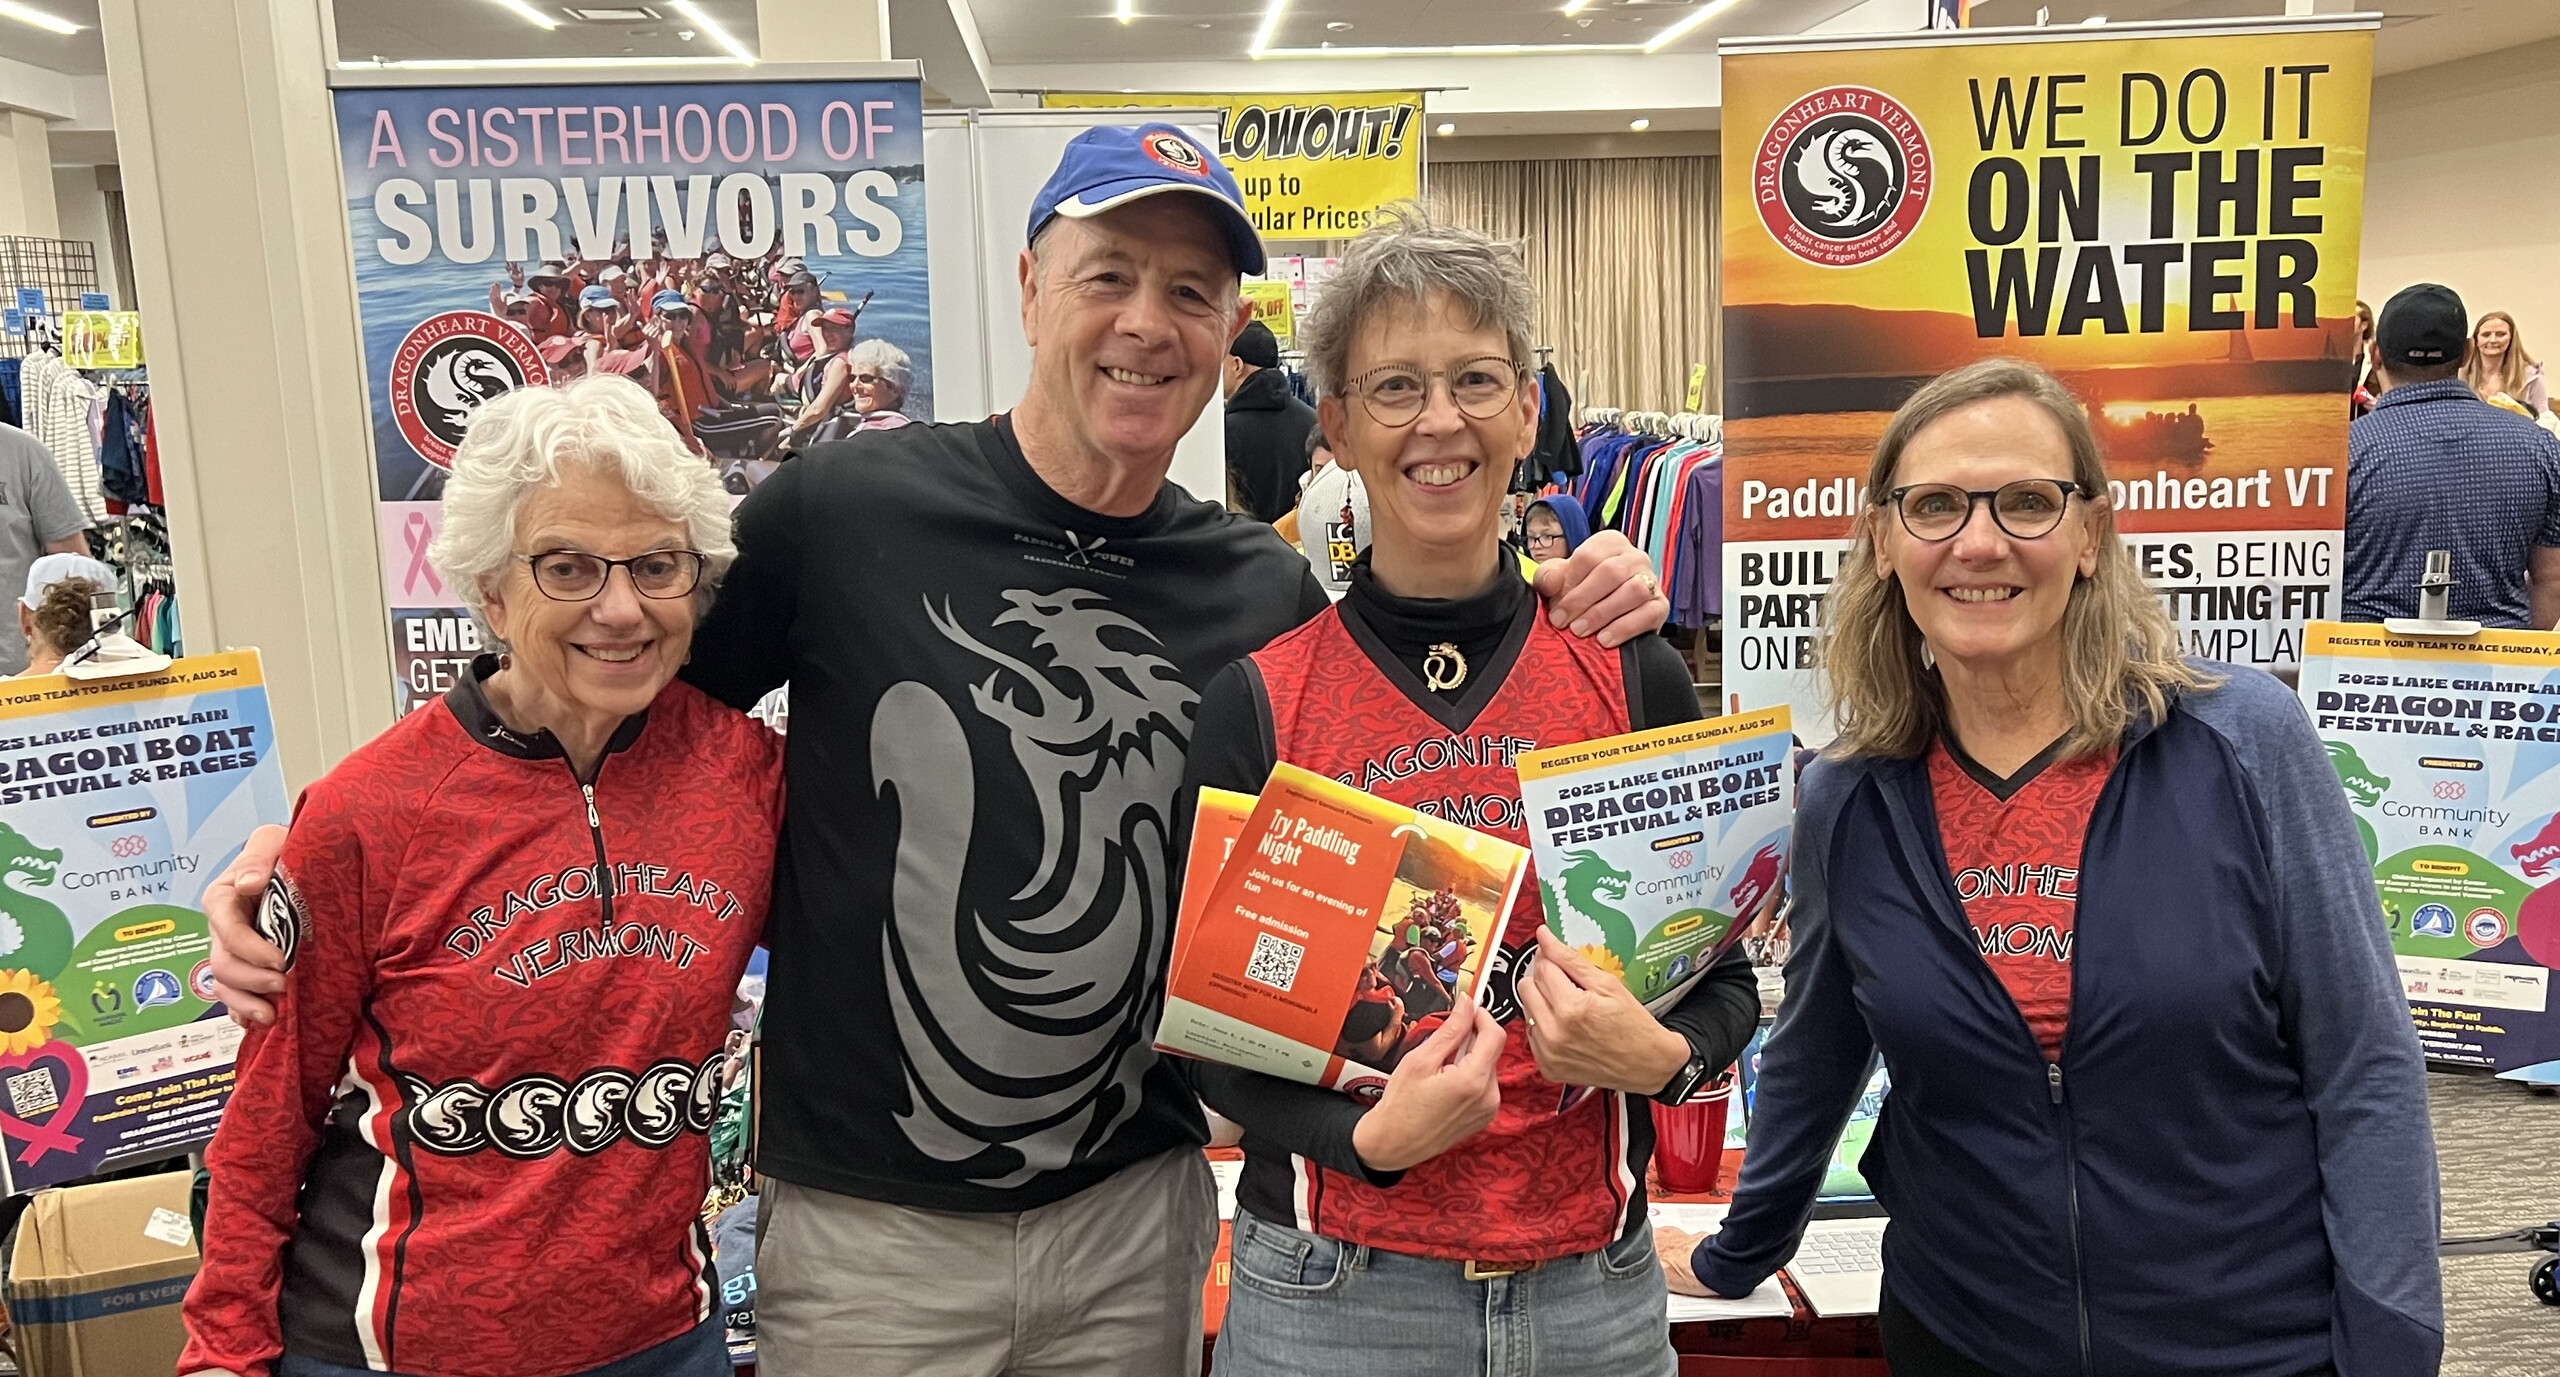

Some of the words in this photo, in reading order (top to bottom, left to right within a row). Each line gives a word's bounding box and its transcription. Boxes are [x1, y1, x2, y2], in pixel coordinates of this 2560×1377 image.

[1968, 75, 2086, 151] WE
[2121, 67, 2227, 147] DO
[2263, 64, 2329, 140] IT
[366, 110, 405, 168] A
[428, 103, 797, 168] SISTERHOOD
[822, 101, 894, 161] OF
[1219, 104, 1416, 162] LOWOUT!
[1761, 93, 1872, 204] DRAGONHEART
[1880, 102, 1926, 200] VERMONT
[1245, 176, 1271, 198] up
[1279, 172, 1300, 196] to
[1968, 155, 2101, 245] ON
[2135, 147, 2324, 239] THE
[375, 171, 903, 265] SURVIVORS
[1252, 206, 1296, 230] ular
[1783, 233, 1823, 259] supporter
[1826, 252, 1857, 263] dragon
[1858, 247, 1878, 258] boat
[1880, 229, 1903, 249] teams
[1788, 222, 1812, 245] breast
[1815, 240, 1844, 252] cancer
[1847, 233, 1881, 251] survivor
[1883, 219, 1898, 235] and
[1964, 239, 2319, 338] WATER
[1266, 298, 1284, 317] OFF
[396, 317, 491, 416] DRAGONHEART
[498, 325, 545, 386] VERMO
[421, 444, 453, 466] support
[423, 434, 448, 456] breast
[2111, 470, 2270, 511] onheart
[2285, 467, 2334, 507] VT
[1013, 533, 1067, 551] PADDLE
[1092, 551, 1136, 567] POWER
[1329, 543, 1357, 562] DB
[2217, 541, 2330, 578] BEING
[2153, 585, 2272, 621] TTING
[2282, 585, 2331, 620] FIT
[405, 618, 484, 652] EMB
[2328, 636, 2381, 648] REGISTER
[2384, 639, 2414, 649] YOUR
[2417, 641, 2448, 650] TEAM
[2451, 643, 2466, 651] TO
[2469, 644, 2499, 653] RACE
[2501, 645, 2552, 656] SUNDAY,
[5, 692, 42, 707] YOUR
[44, 687, 80, 701] TEAM
[82, 684, 99, 696] TO
[102, 681, 136, 693] RACE
[137, 674, 191, 689] SUNDAY,
[192, 669, 217, 682] AUG
[219, 667, 238, 679] 3rd
[2338, 673, 2388, 686] 2025
[2392, 676, 2448, 689] LAKE
[2316, 691, 2482, 719] DRAGON
[2489, 700, 2560, 723] BOA
[0, 738, 26, 751] 25
[30, 727, 93, 748] LAKE
[97, 708, 229, 738] CHAMPLAIN
[145, 725, 256, 762] BOAT
[1541, 753, 1590, 770] REGISTER
[1592, 748, 1620, 760] YOUR
[1622, 742, 1650, 754] TEAM
[1652, 738, 1666, 748] TO
[1667, 733, 1694, 746] RACE
[1696, 726, 1738, 740] SUNDAY,
[1739, 720, 1759, 732] AUG
[1760, 717, 1775, 728] 3rd
[2318, 714, 2460, 737] FESTIVAL
[2465, 723, 2488, 739] &
[2493, 726, 2560, 743] RAC
[0, 772, 122, 806] STIVAL
[128, 767, 151, 786] &
[157, 750, 258, 780] RACES
[1558, 782, 1605, 800] 2025
[1609, 772, 1659, 791] LAKE
[1662, 750, 1764, 781] CHAMPLAIN
[1544, 782, 1694, 829] DRAGON
[1698, 763, 1783, 798] BOAT
[1552, 810, 1680, 848] FESTIVAL
[1685, 805, 1702, 822] &
[1707, 787, 1780, 817] RACES
[2382, 801, 2510, 827] Community
[1269, 808, 1293, 839] Try
[1293, 817, 1362, 866] Paddling
[1691, 832, 1701, 842] BY
[2419, 825, 2473, 838] BANK
[1257, 832, 1303, 867] Night
[62, 852, 200, 891] Community
[1244, 879, 1262, 894] fun
[1635, 864, 1726, 896] Community
[1954, 863, 2079, 902] ONHE
[110, 881, 170, 902] BANK
[1248, 868, 1271, 883] Join
[1271, 877, 1284, 888] us
[1286, 880, 1301, 893] for
[1302, 888, 1315, 898] an
[1315, 893, 1354, 915] evening
[1356, 907, 1369, 918] of
[1665, 889, 1703, 905] BANK
[1235, 905, 1258, 922] Free
[1260, 912, 1310, 939] admission
[492, 919, 709, 988] VERMONT
[1972, 922, 2074, 962] MON
[1259, 987, 1272, 998] FOR
[2409, 1007, 2428, 1017] oin
[2430, 1008, 2453, 1019] The
[2454, 1010, 2482, 1022] Fun!
[115, 1090, 154, 1107] Come
[155, 1083, 182, 1098] Join
[183, 1077, 208, 1090] The
[102, 1292, 135, 1308] FOR
